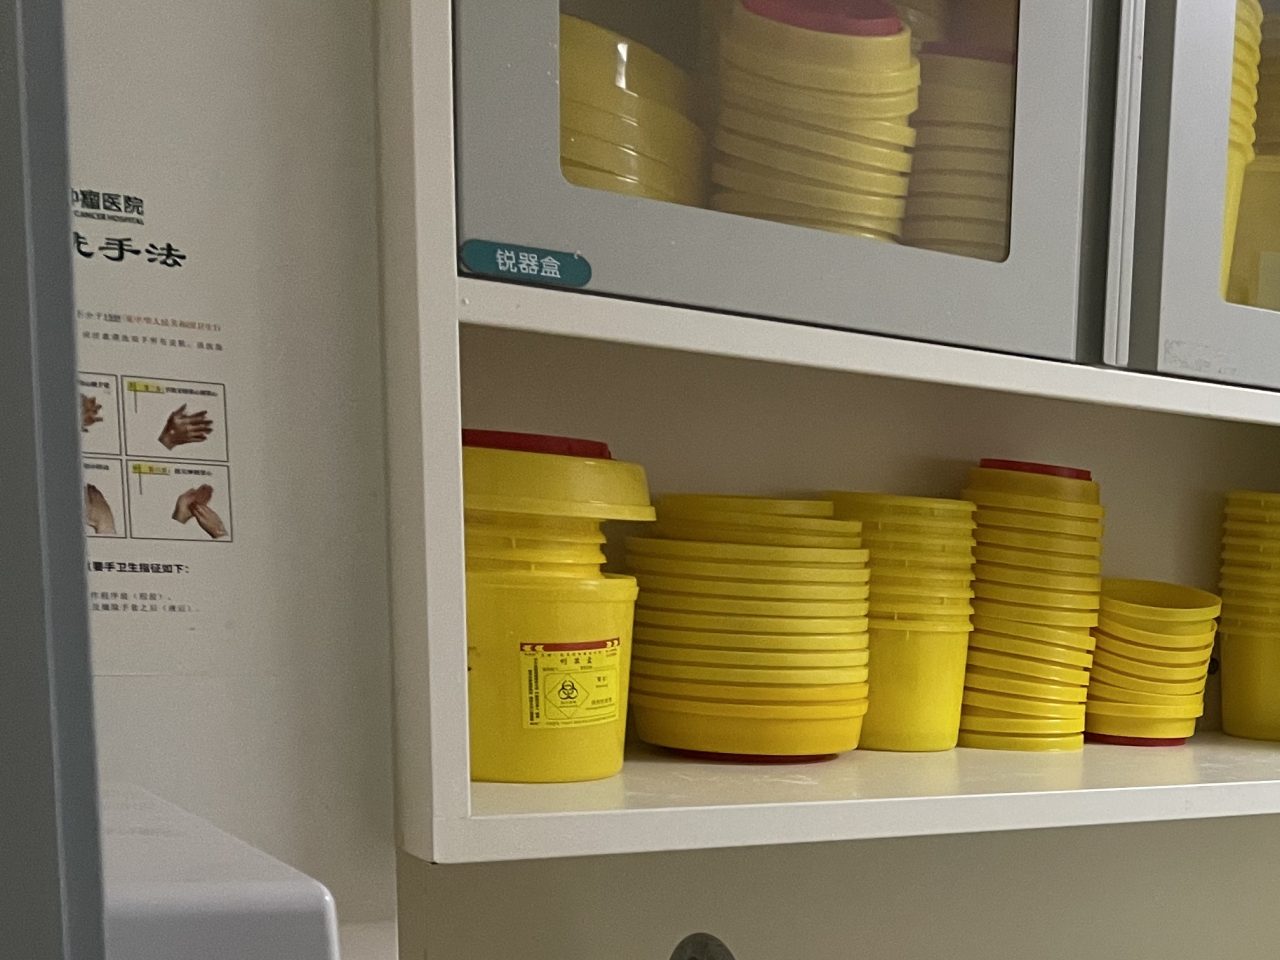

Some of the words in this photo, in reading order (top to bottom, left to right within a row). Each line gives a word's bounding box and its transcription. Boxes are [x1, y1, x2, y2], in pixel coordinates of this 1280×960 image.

[72, 188, 144, 216] 瘤医院
[496, 248, 561, 278] 锐器盒
